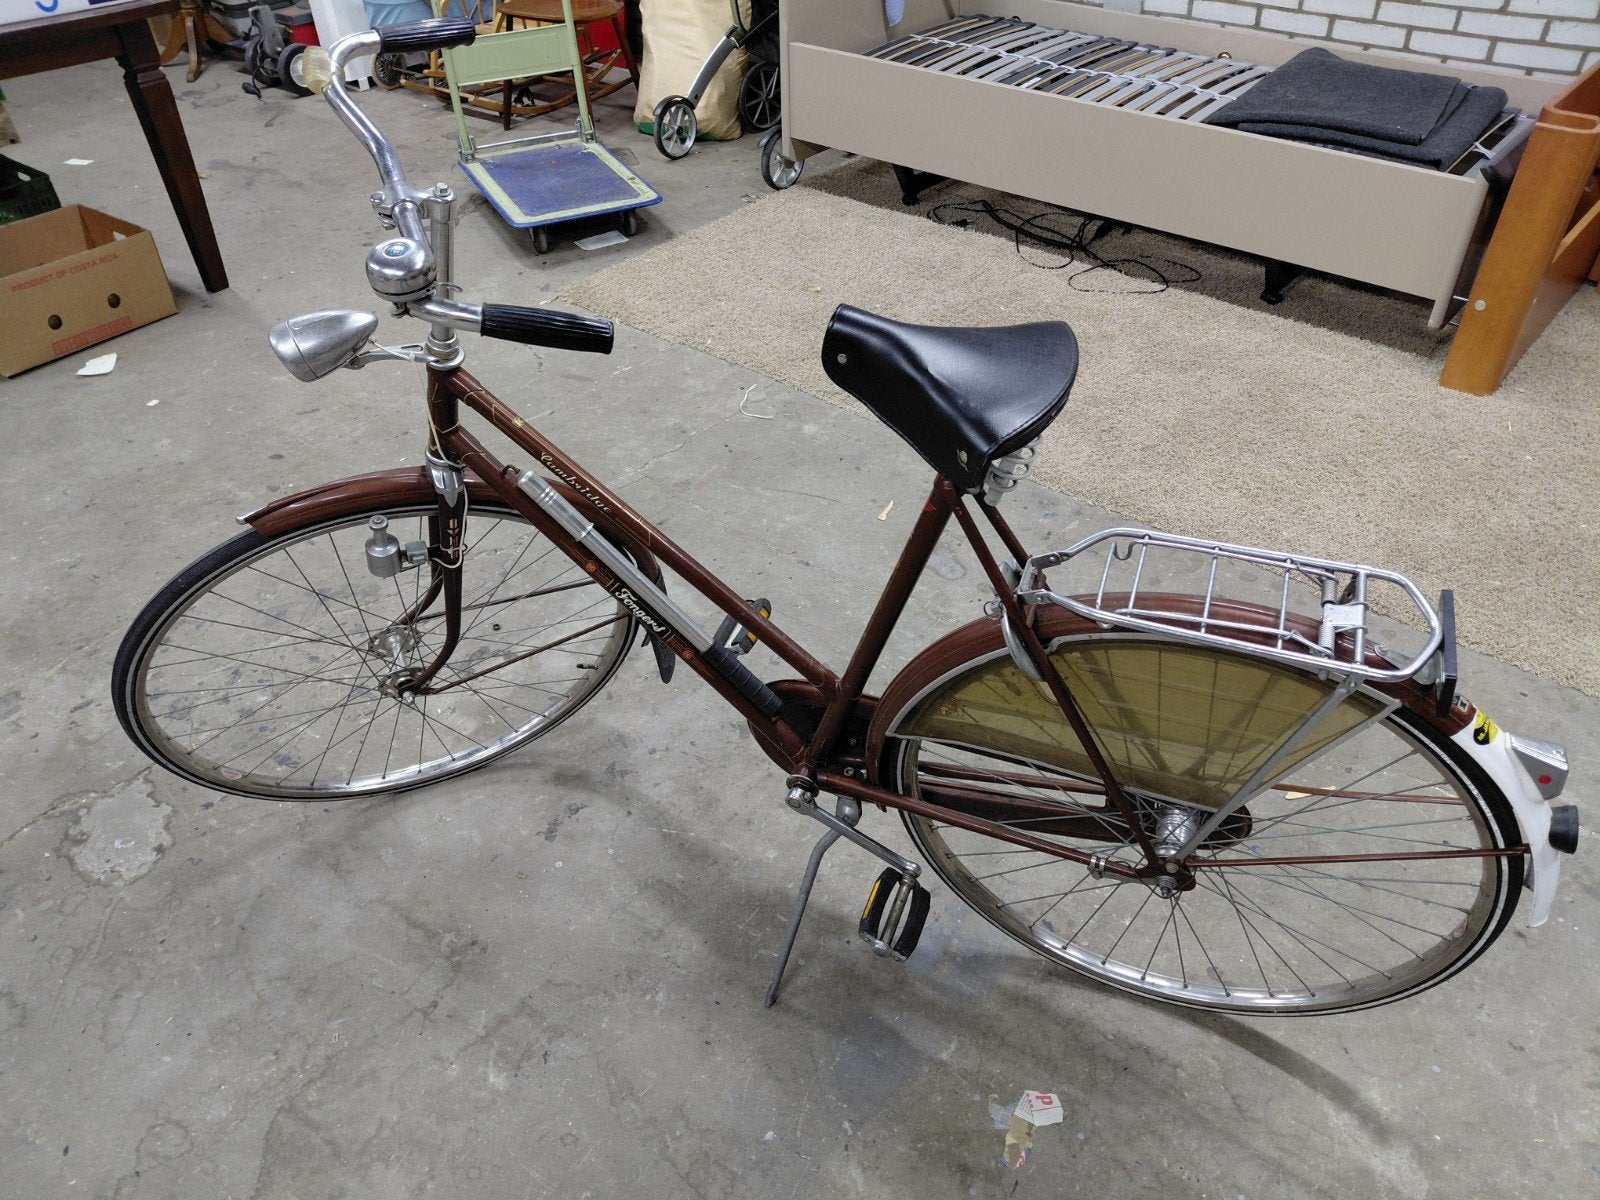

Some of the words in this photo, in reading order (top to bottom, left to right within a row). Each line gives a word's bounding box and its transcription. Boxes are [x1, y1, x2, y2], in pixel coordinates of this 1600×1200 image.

[11, 273, 54, 293] PRODUCT
[55, 269, 67, 279] OF
[68, 260, 98, 274] COSTA
[99, 252, 118, 265] RICA
[614, 587, 666, 633] Fongers
